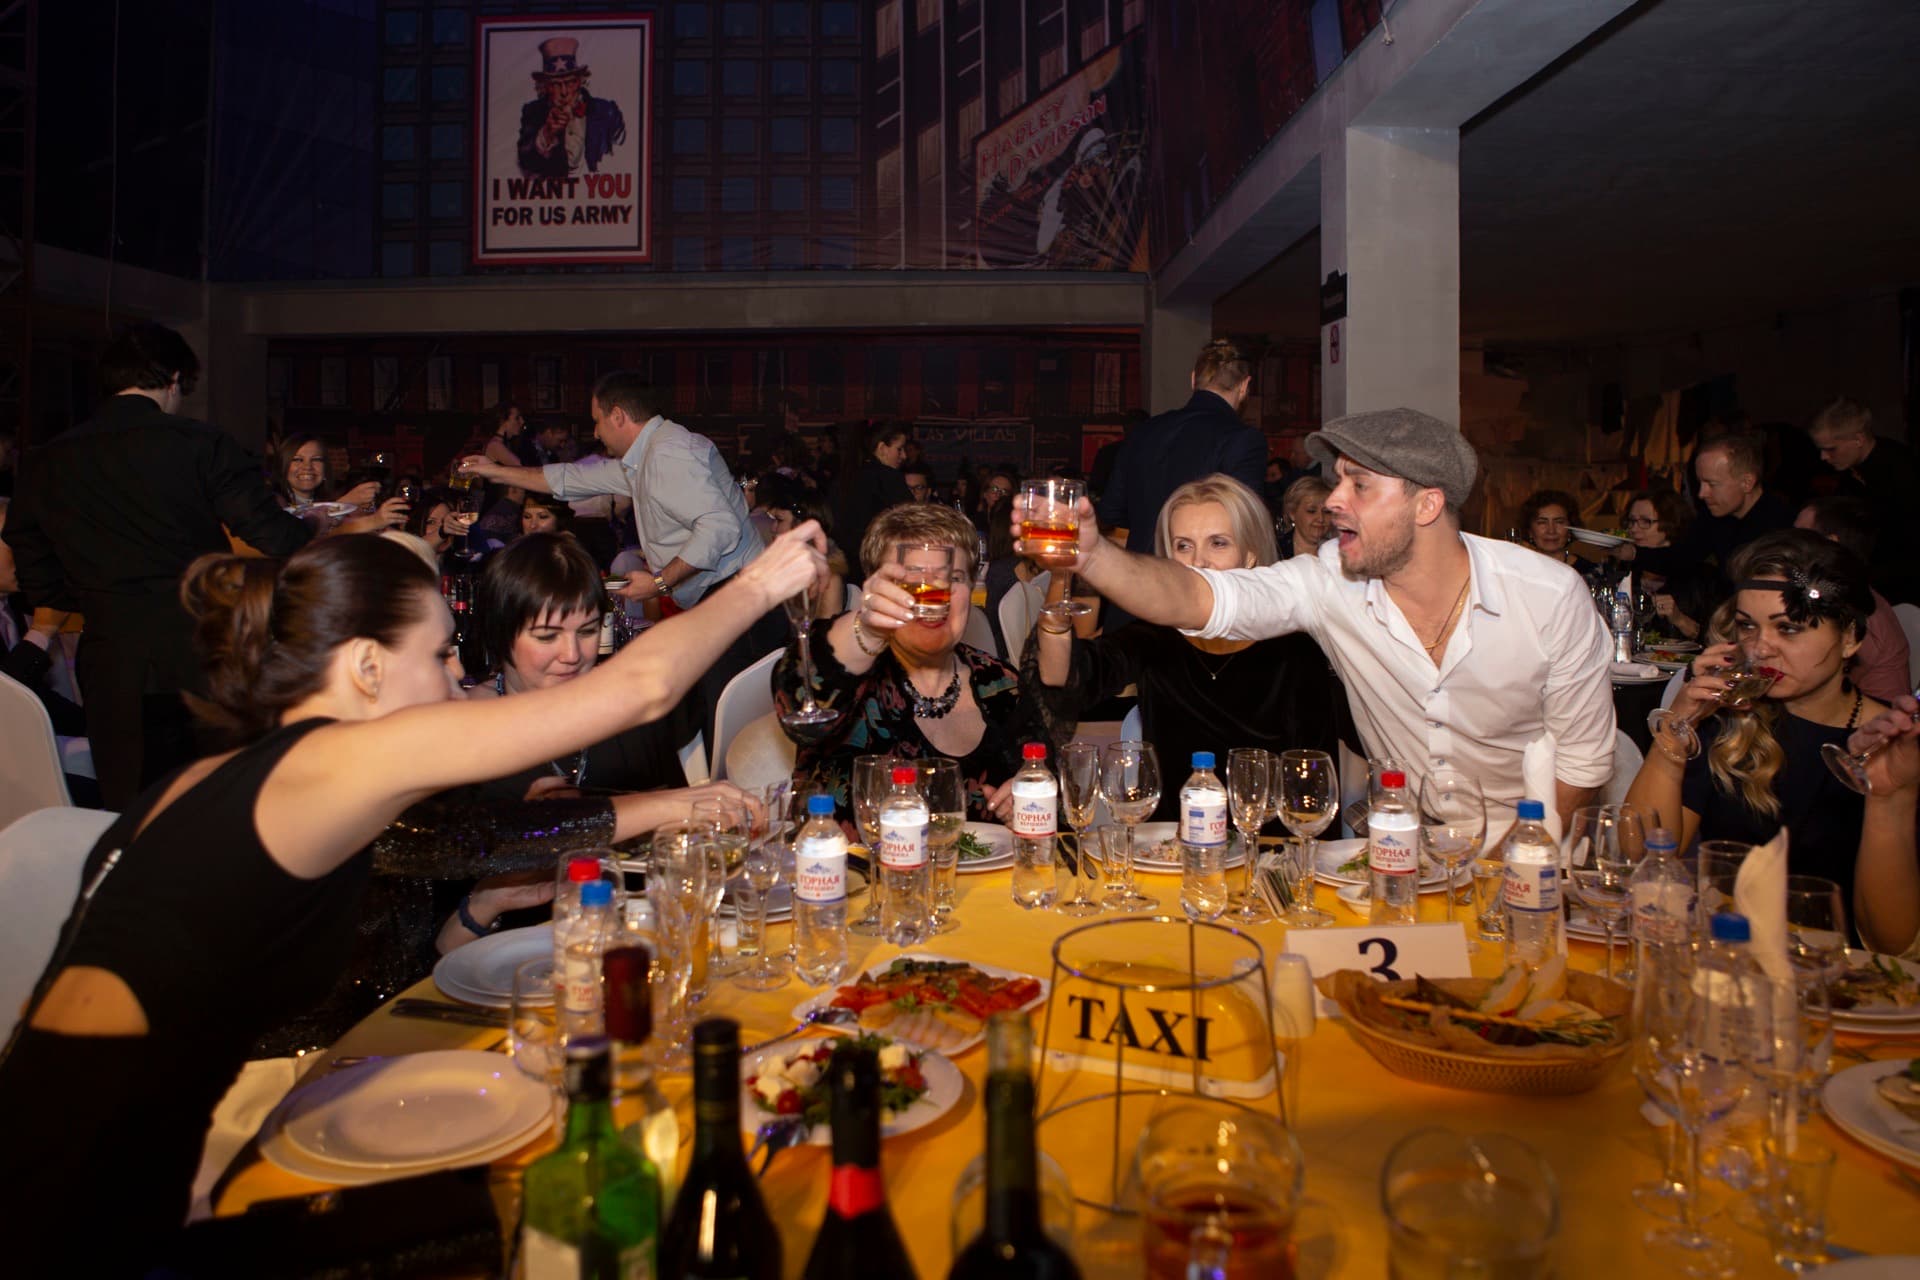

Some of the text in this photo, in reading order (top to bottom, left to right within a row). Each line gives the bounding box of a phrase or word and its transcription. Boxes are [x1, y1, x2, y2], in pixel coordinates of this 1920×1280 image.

[493, 173, 632, 201] I WANT YOU
[492, 204, 633, 227] FOR US ARMY
[1016, 812, 1052, 822] ГОРНАЯ
[1371, 845, 1411, 858] ГОРНАЯ
[800, 874, 840, 885] ГОРНАЯ
[1358, 938, 1401, 981] 3
[1068, 994, 1213, 1063] TAXI
